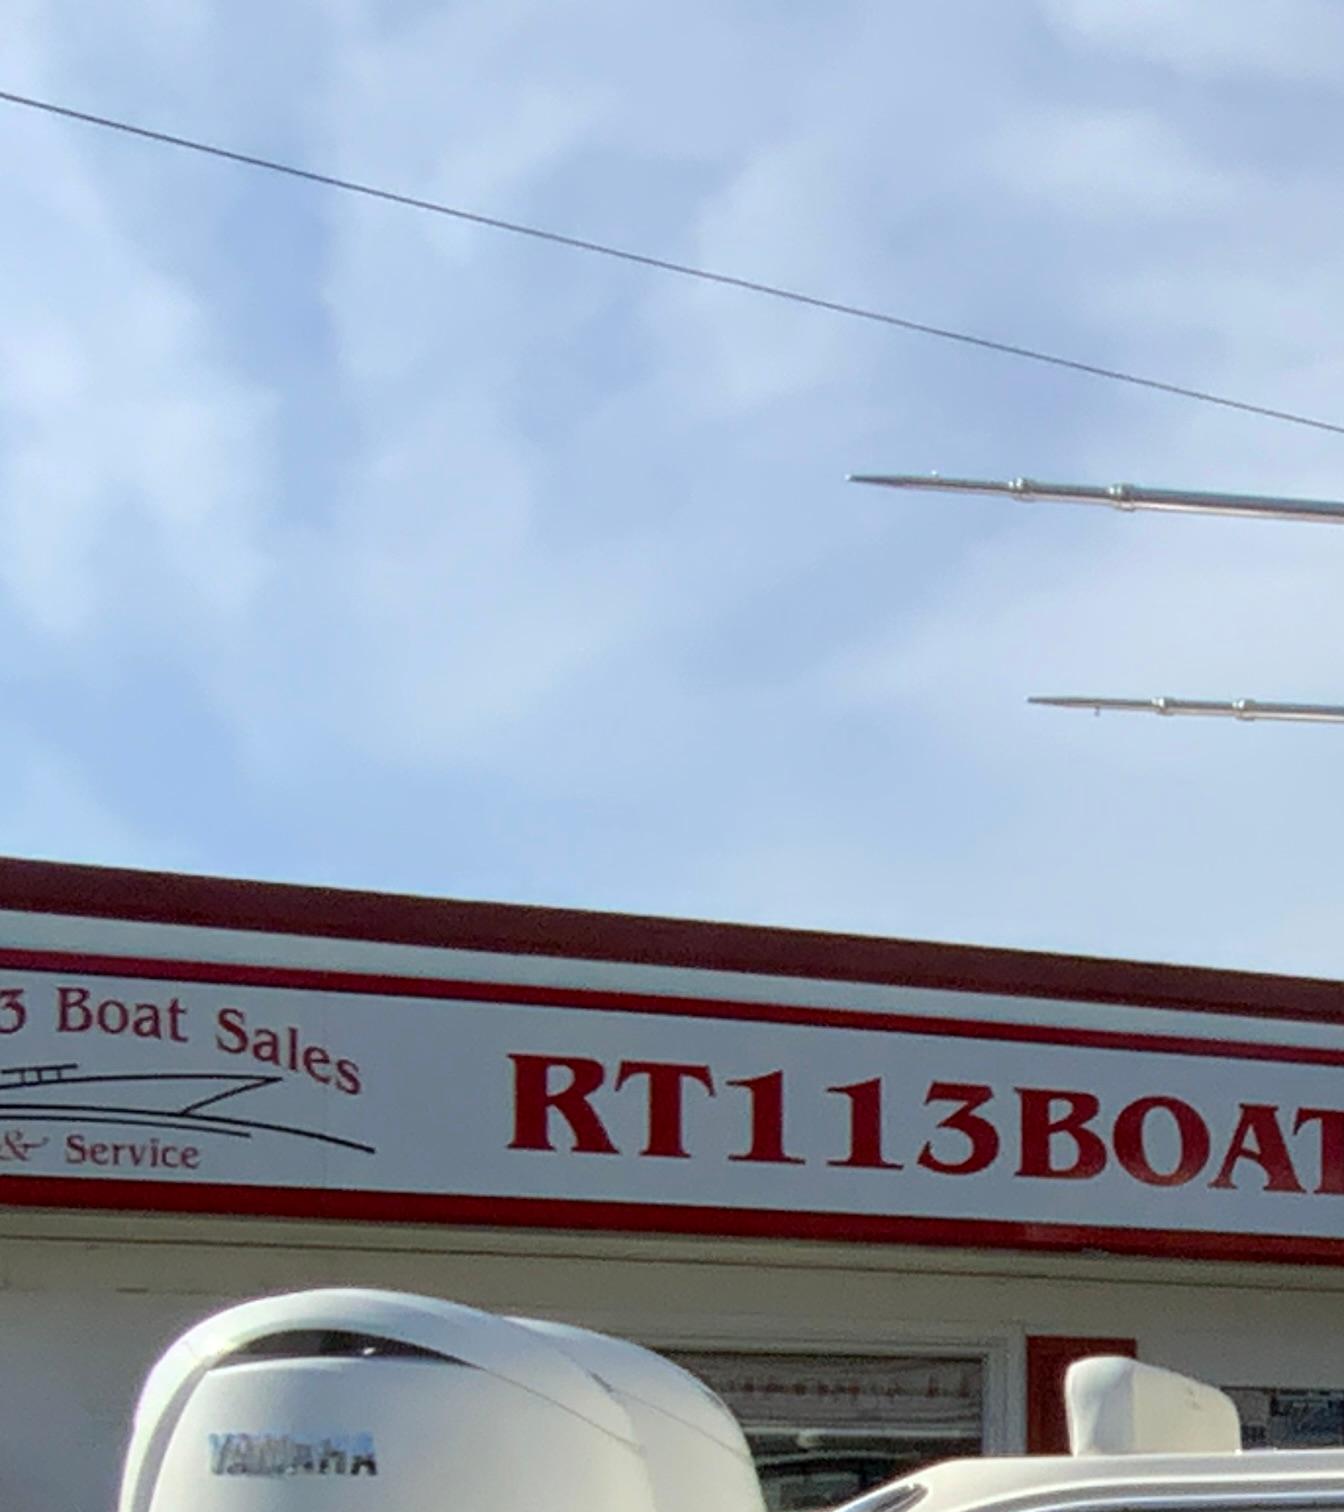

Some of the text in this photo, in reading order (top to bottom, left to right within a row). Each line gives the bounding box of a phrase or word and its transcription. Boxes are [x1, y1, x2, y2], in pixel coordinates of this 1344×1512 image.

[56, 986, 189, 1043] Boat
[216, 1007, 362, 1096] Sales
[65, 1134, 201, 1169] Service
[210, 1433, 378, 1476] YAMAHA
